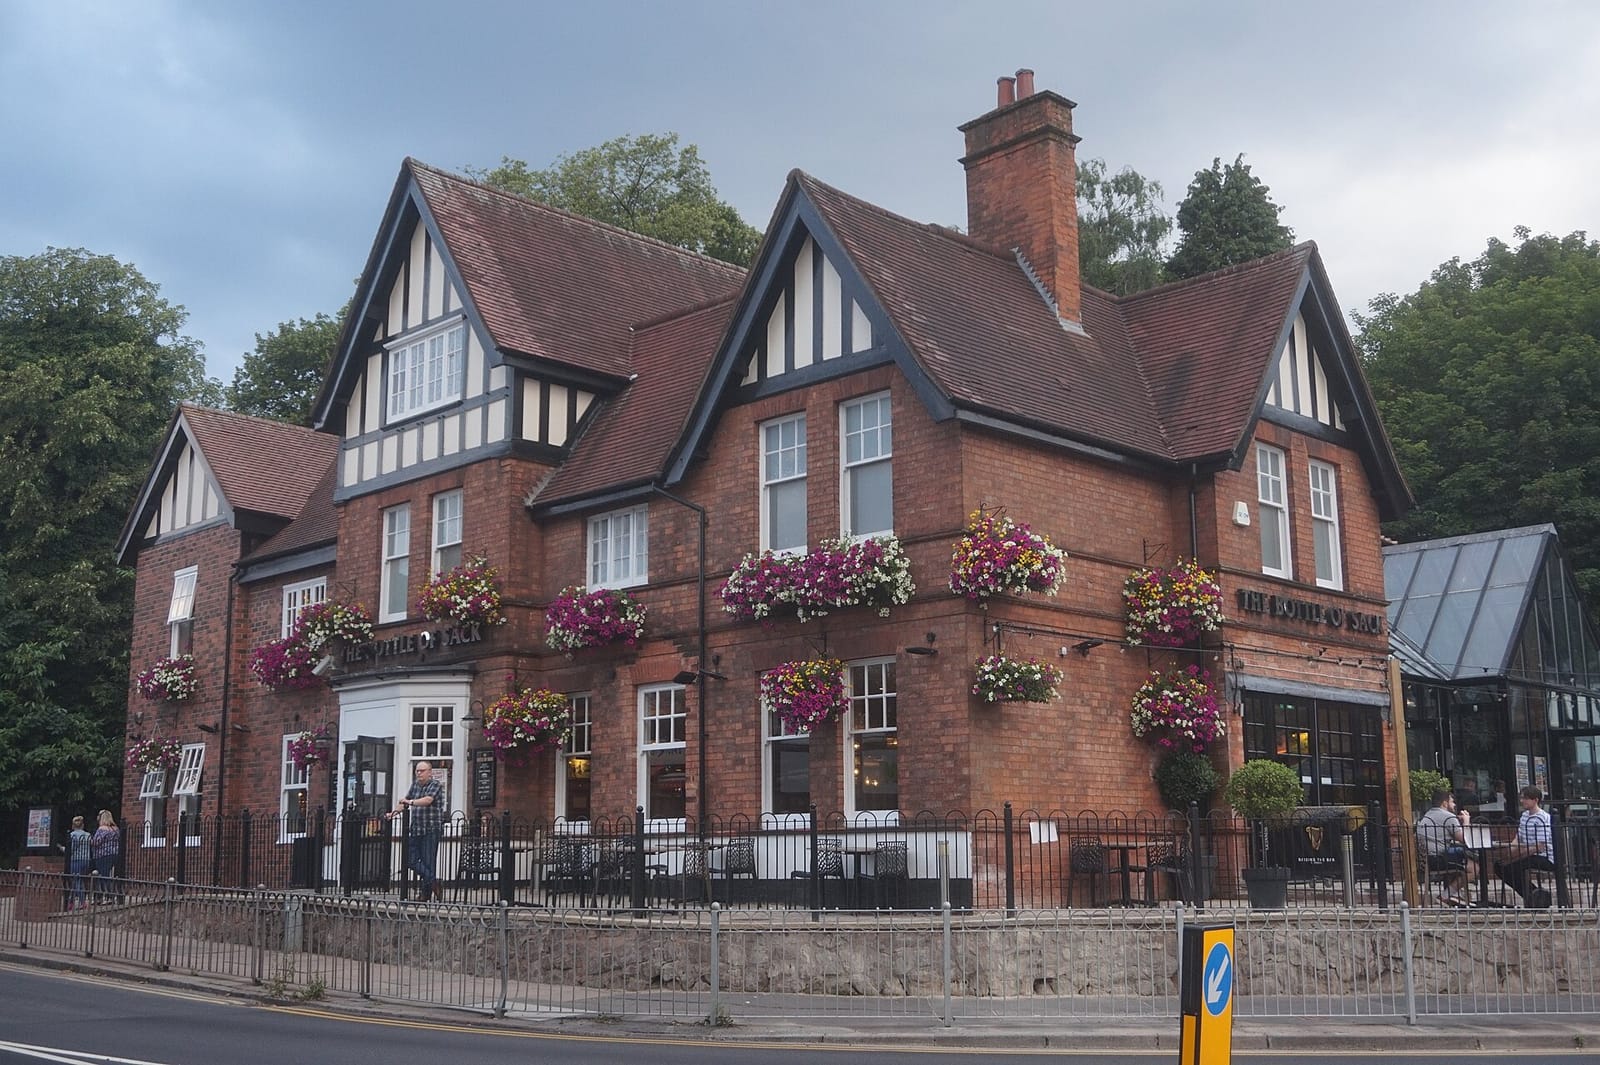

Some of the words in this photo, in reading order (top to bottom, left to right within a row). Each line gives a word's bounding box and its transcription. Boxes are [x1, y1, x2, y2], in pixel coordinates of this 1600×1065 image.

[1238, 590, 1270, 613] THE
[1272, 595, 1327, 624] BOTTLE
[365, 635, 414, 660] OTTLE
[441, 621, 481, 646] SACK
